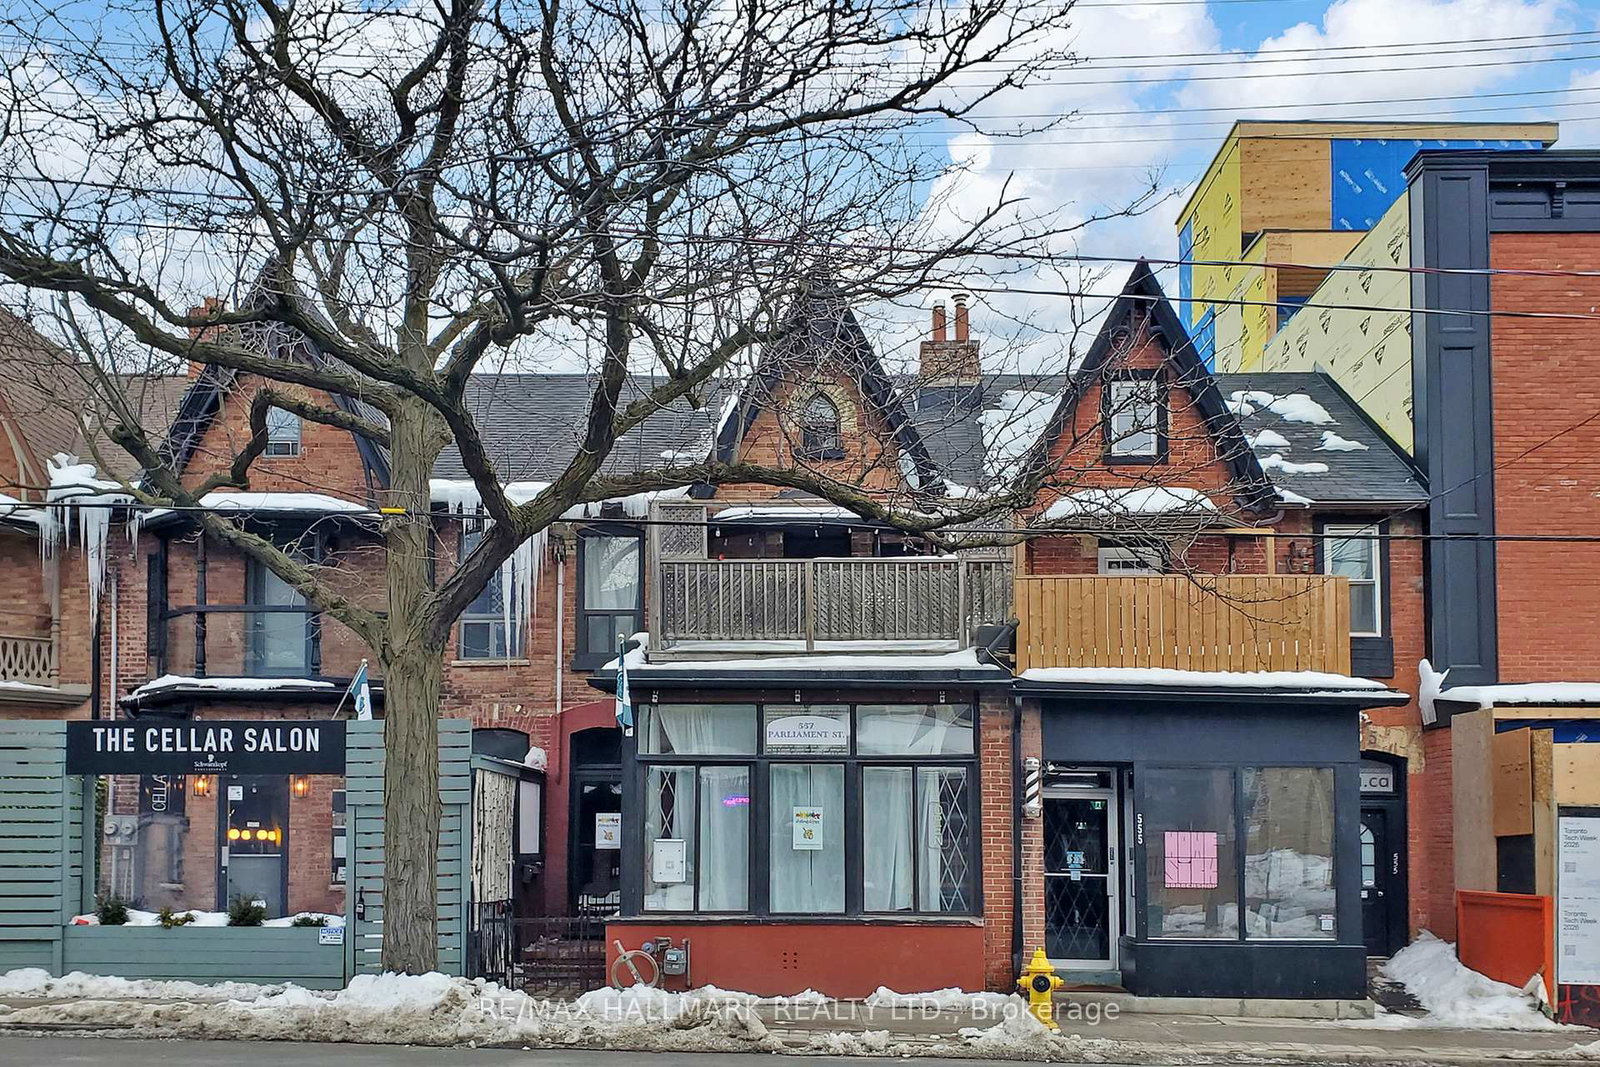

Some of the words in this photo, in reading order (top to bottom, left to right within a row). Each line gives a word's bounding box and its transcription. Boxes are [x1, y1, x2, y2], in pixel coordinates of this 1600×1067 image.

[93, 728, 135, 751] THE
[146, 728, 233, 751] CELLAR
[244, 728, 320, 751] SALON
